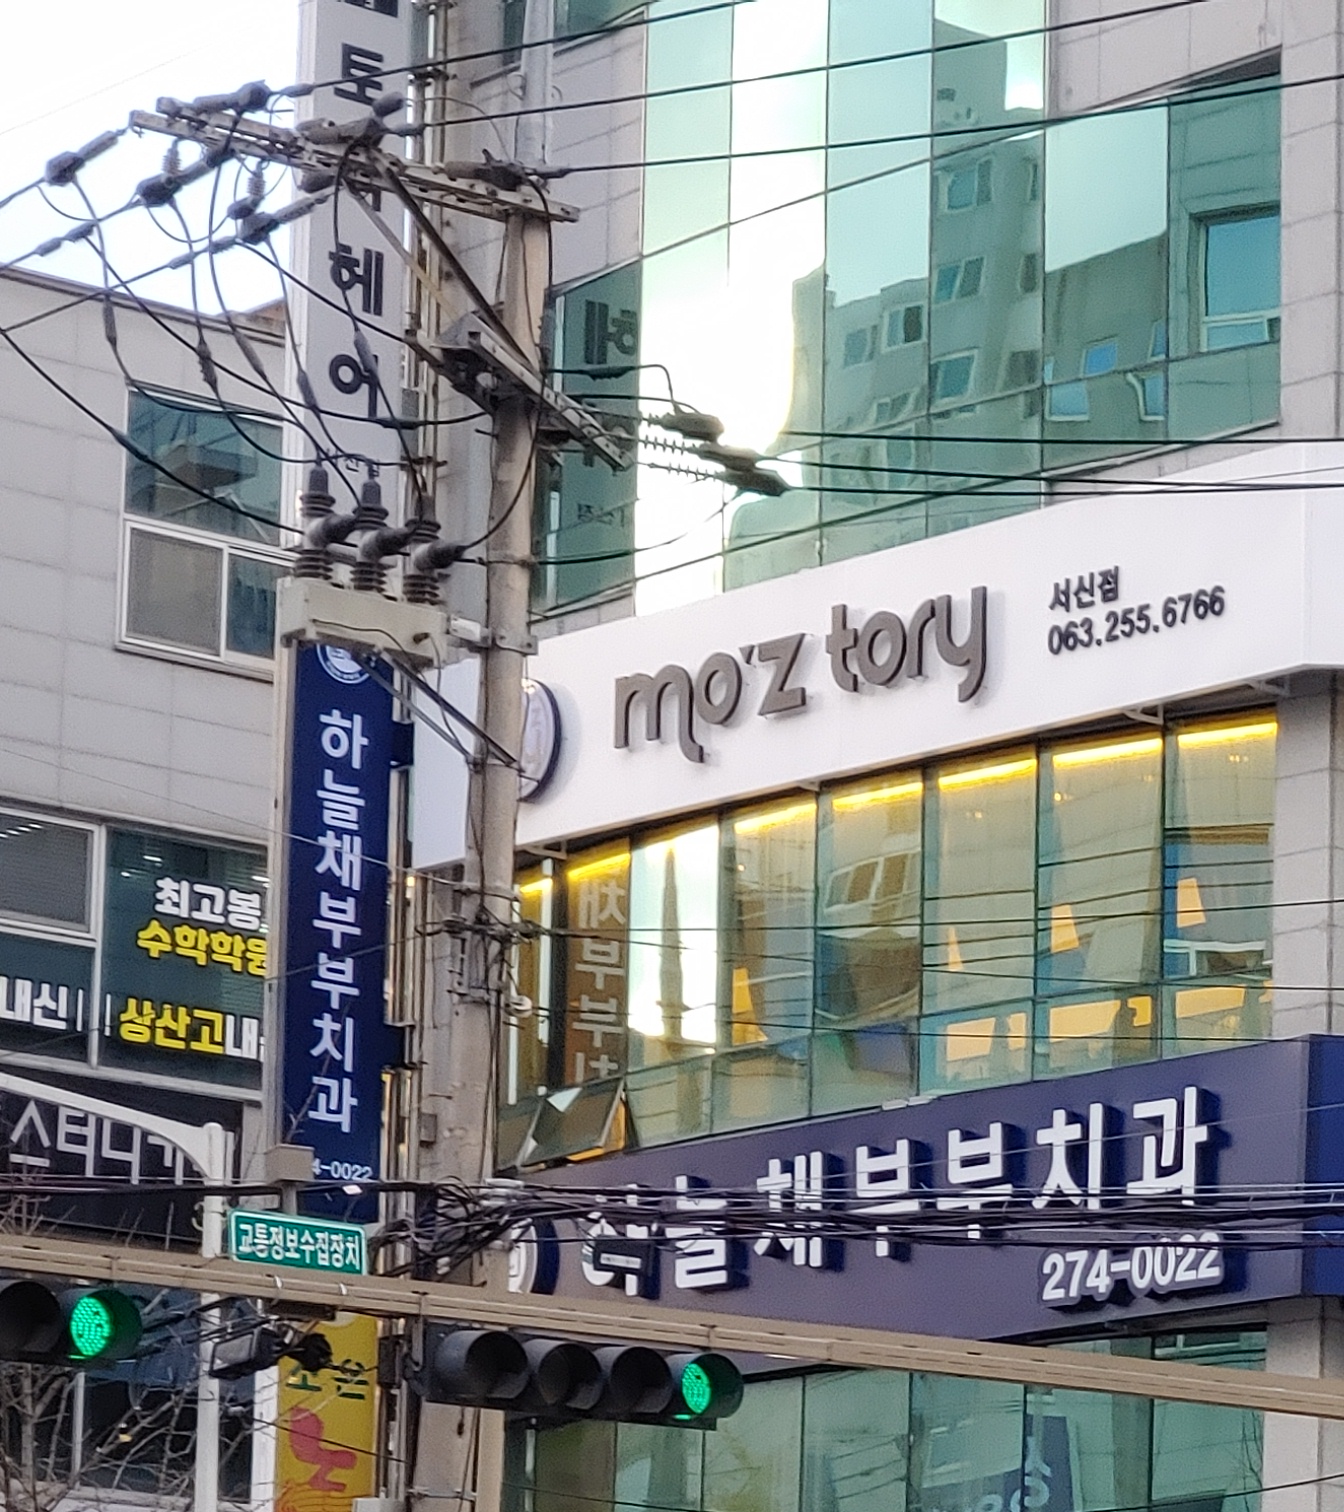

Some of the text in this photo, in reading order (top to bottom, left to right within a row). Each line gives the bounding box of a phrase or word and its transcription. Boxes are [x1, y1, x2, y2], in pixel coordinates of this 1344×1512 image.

[1047, 585, 1227, 656] 063.255.6766
[1049, 566, 1122, 613] 서신점
[826, 585, 988, 703] tory
[136, 919, 269, 977] 수학학원
[306, 709, 371, 1135] 하늘채부부치과
[119, 997, 264, 1062] 상산고내
[235, 1221, 363, 1272] 교통정보수집장치
[1040, 1230, 1225, 1302] 274-0022
